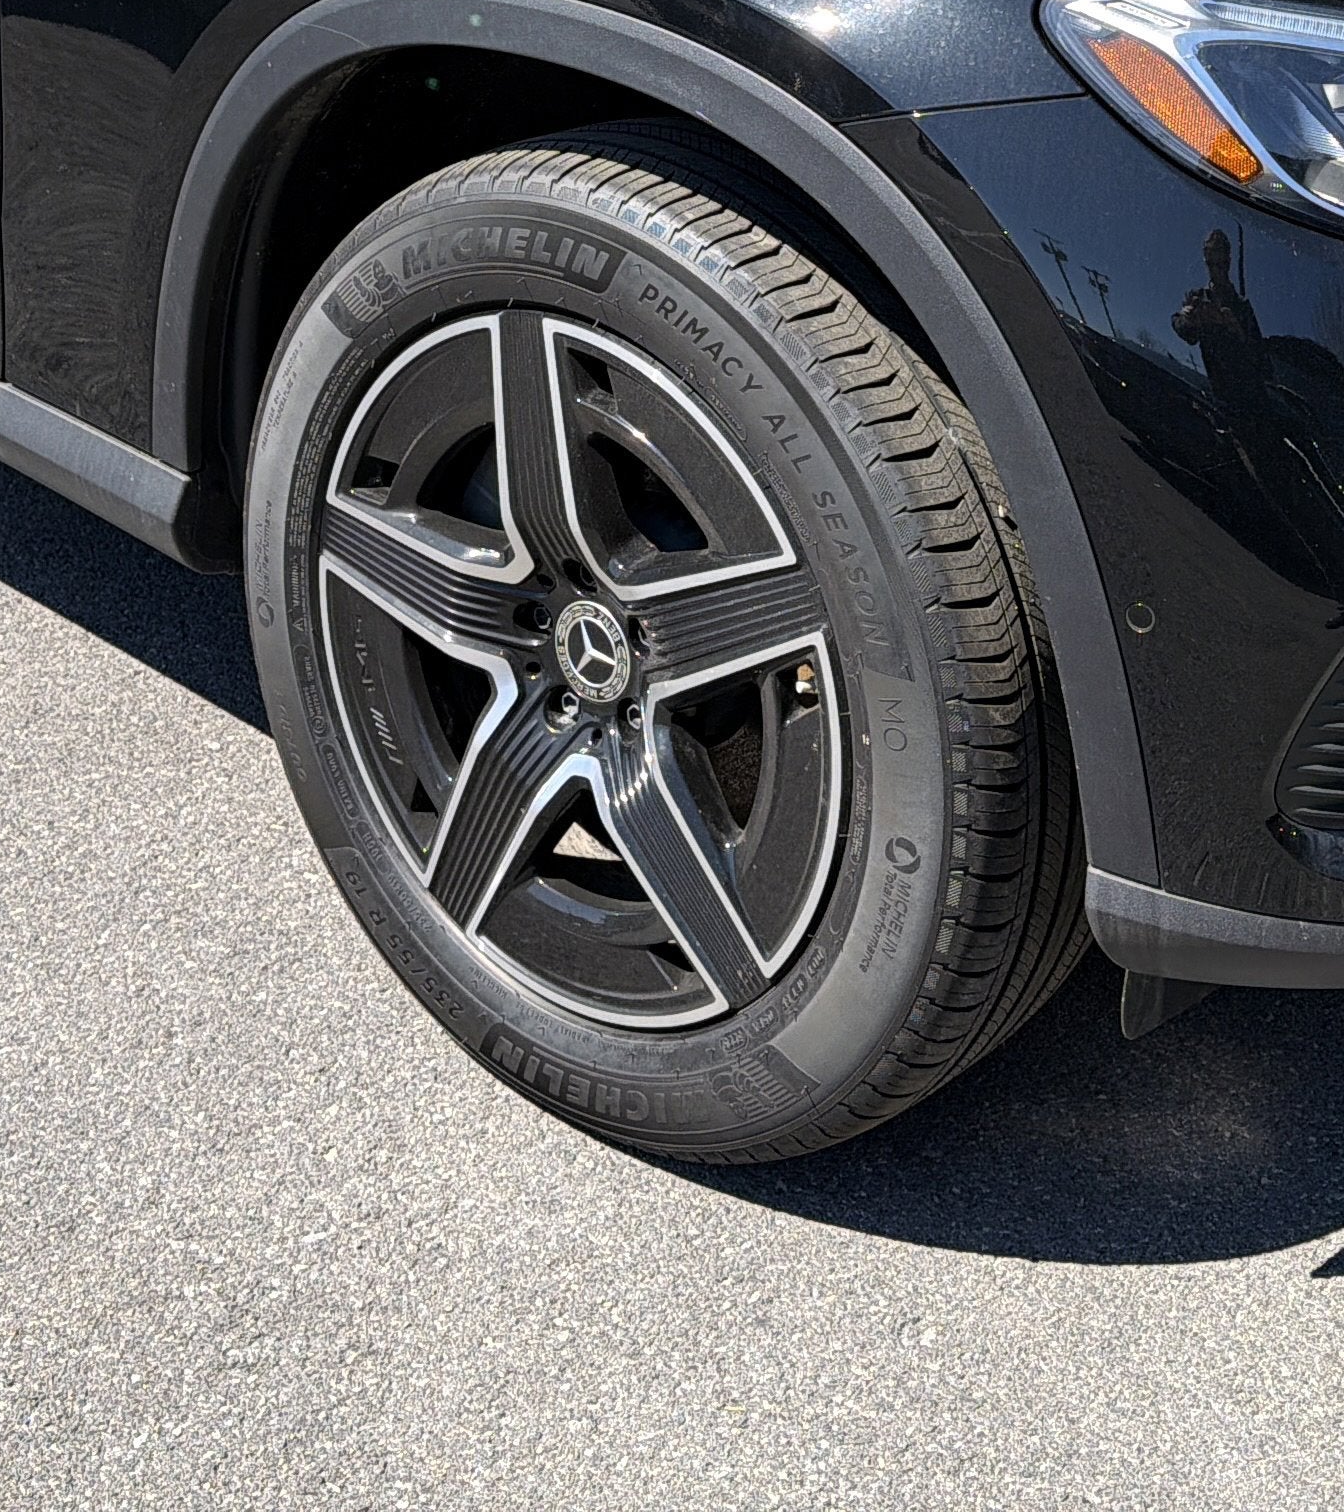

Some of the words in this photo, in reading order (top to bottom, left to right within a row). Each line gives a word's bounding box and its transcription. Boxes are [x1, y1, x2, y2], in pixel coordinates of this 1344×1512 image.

[401, 225, 611, 282] MICHELIN
[638, 285, 764, 395] PRIMACY
[761, 412, 812, 475] ALL
[811, 489, 889, 647] SEASON
[878, 696, 907, 753] MO
[344, 870, 364, 897] 19
[368, 909, 388, 926] R
[884, 867, 898, 899] Total
[885, 881, 913, 961] MICHELIN
[859, 898, 892, 974] Performance
[386, 933, 465, 1021] 235/55
[491, 1035, 712, 1125] MICHELIN
